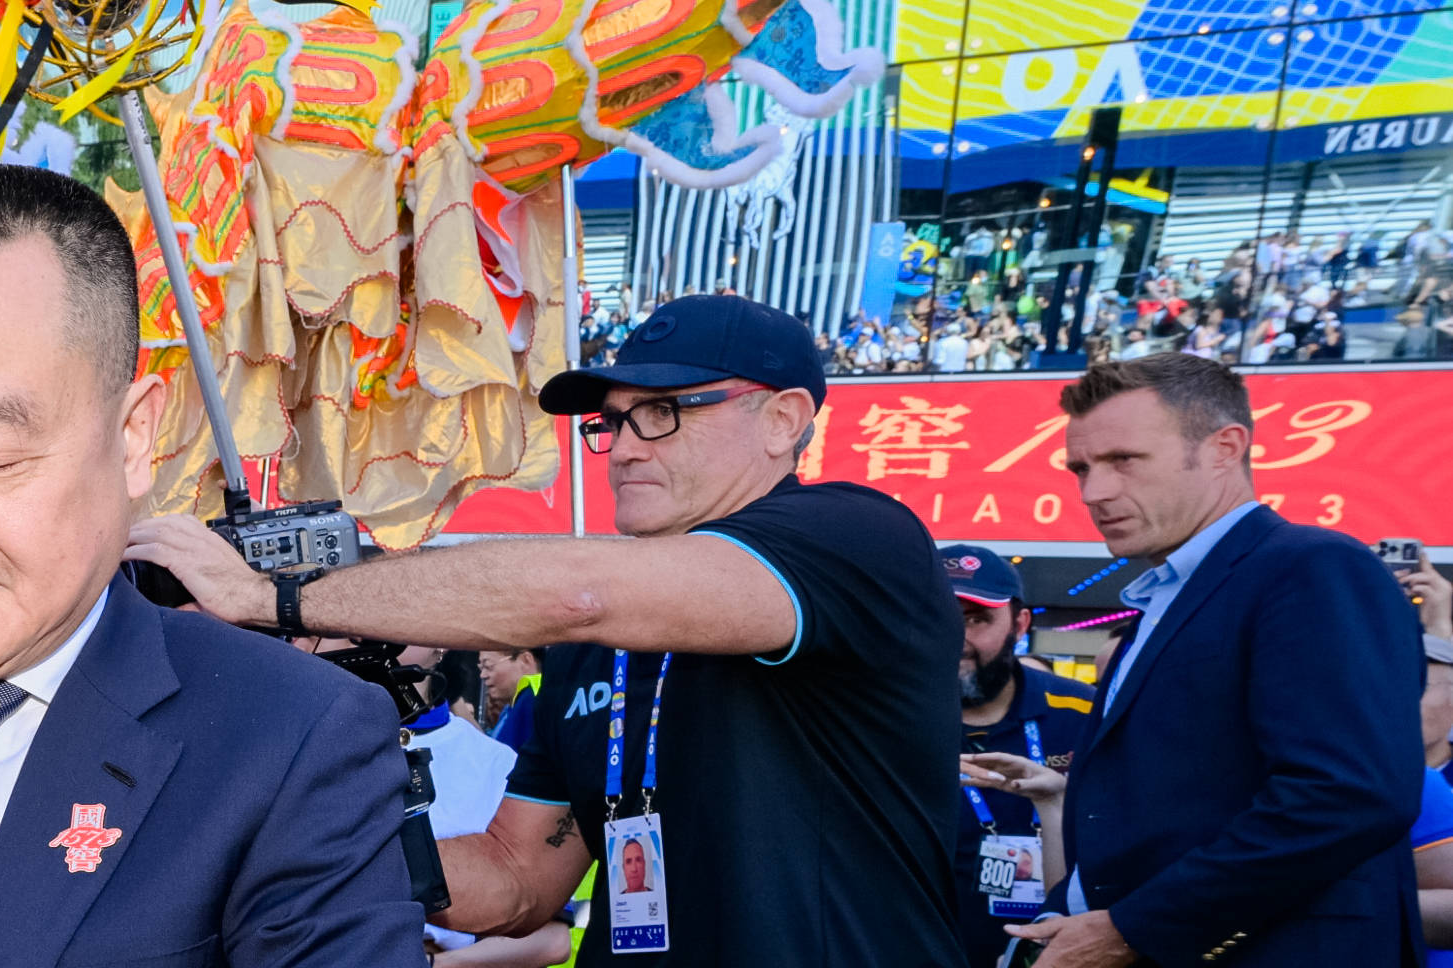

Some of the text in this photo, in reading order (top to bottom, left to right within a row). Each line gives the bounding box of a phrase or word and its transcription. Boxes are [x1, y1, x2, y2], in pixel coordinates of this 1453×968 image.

[309, 514, 342, 527] SONY
[893, 493, 1063, 524] IAO
[980, 857, 1016, 889] 800
